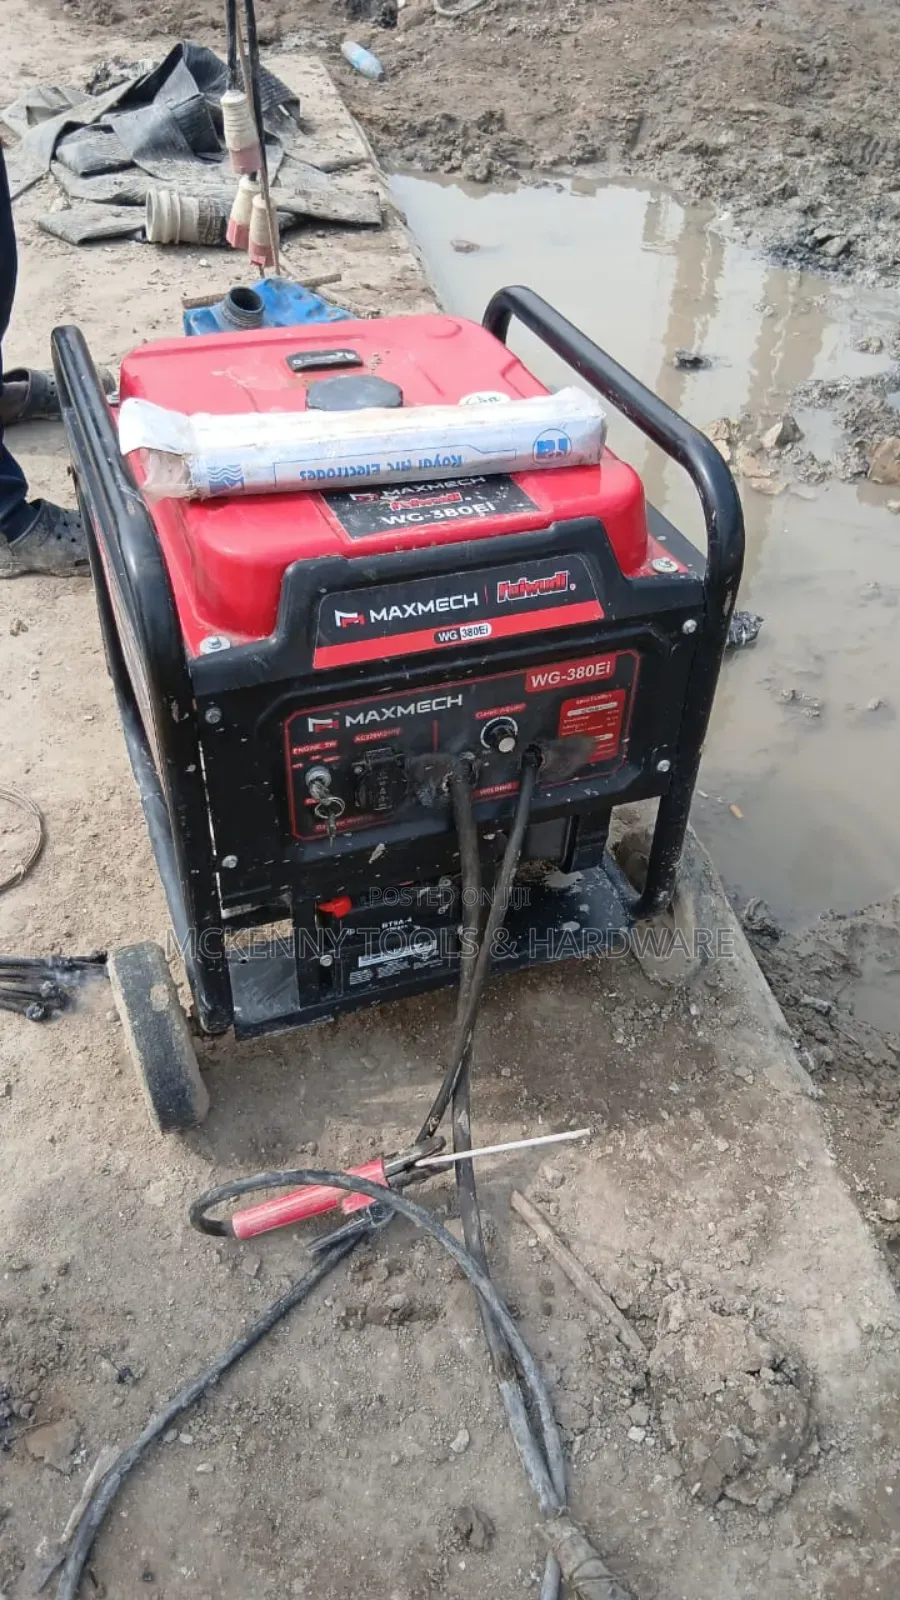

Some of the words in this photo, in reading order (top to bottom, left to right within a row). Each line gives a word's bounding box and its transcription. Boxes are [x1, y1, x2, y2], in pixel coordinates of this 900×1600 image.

[299, 463, 381, 481] Electrodes
[382, 476, 487, 497] MAXMECH
[381, 502, 497, 526] WG-380Ei
[370, 592, 479, 624] MAXMECH
[438, 629, 459, 643] WG
[460, 624, 490, 639] 380Ei
[531, 661, 611, 689] WG-380Ei
[345, 693, 464, 729] MAXMECH
